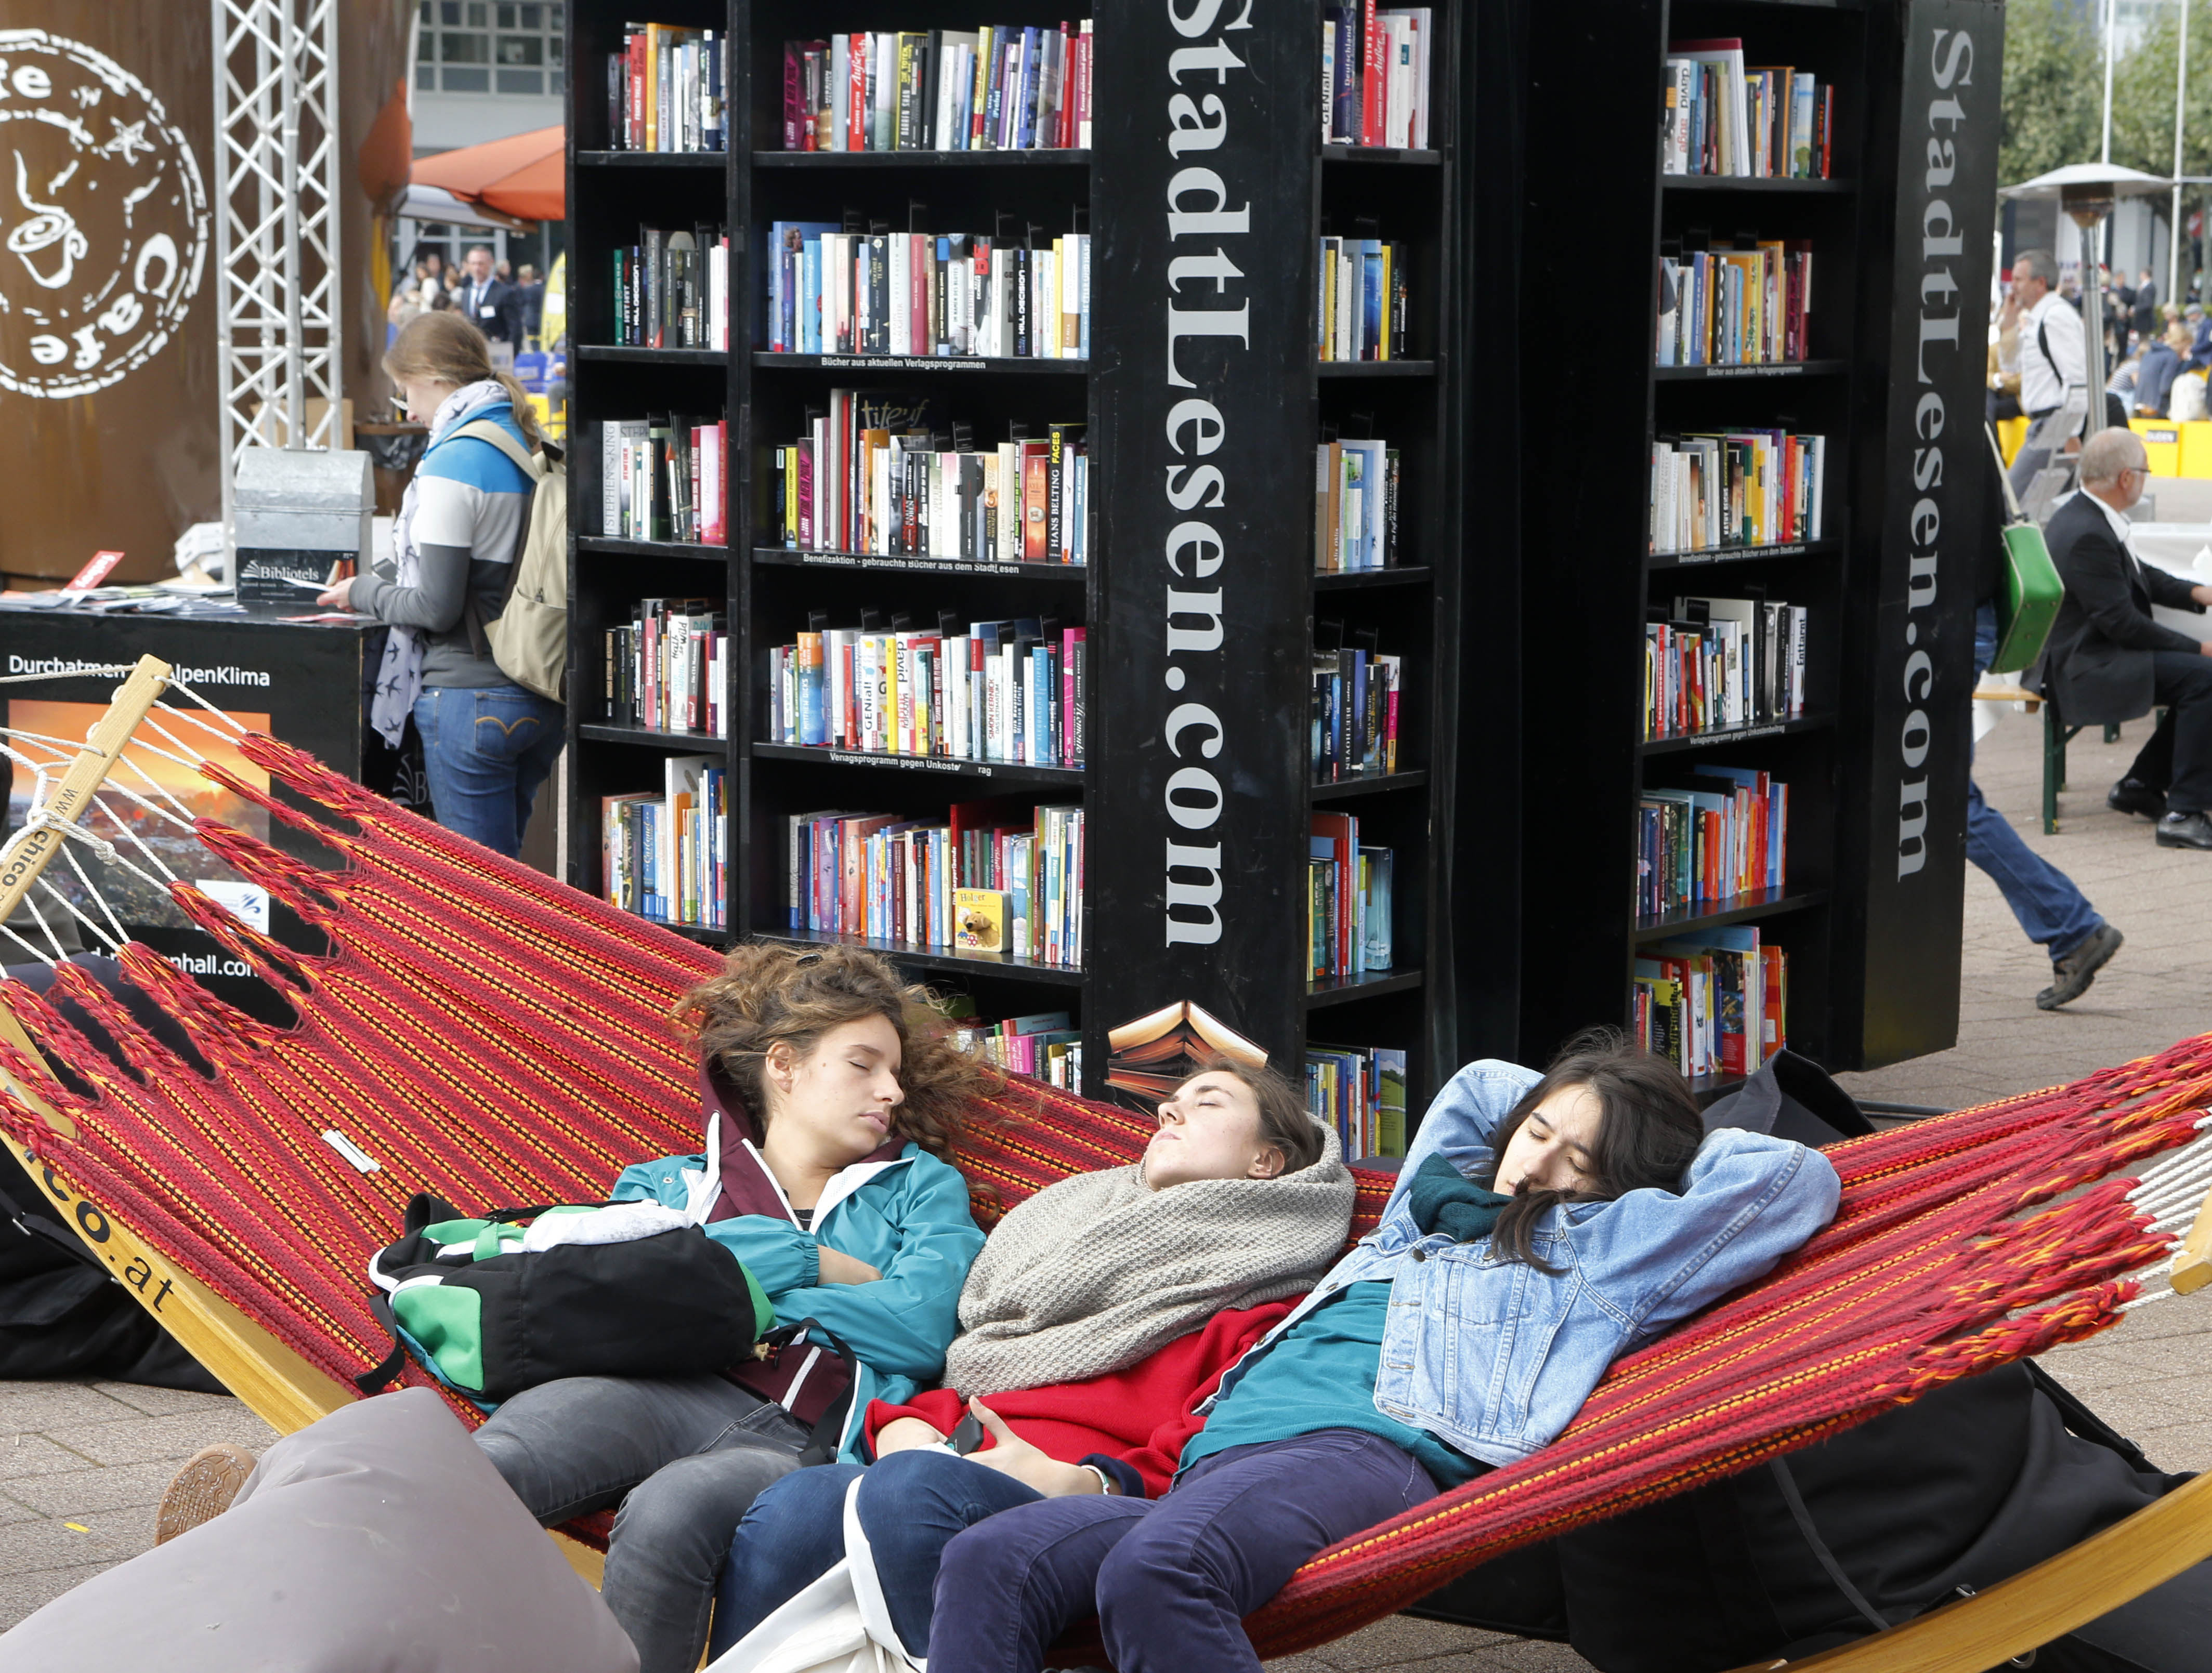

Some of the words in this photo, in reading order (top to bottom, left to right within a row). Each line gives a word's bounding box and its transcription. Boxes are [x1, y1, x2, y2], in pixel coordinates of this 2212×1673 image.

[851, 49, 864, 87] Außer
[1374, 38, 1385, 76] Außer
[901, 89, 910, 107] SHAN
[1680, 68, 1689, 108] david
[900, 110, 910, 136] DARREN
[30, 232, 178, 371] Cafe
[821, 357, 849, 367] Bücher
[867, 358, 904, 367] aktuellen
[905, 359, 986, 370] Verlagsprogrammen
[605, 426, 615, 455] KING
[1052, 431, 1060, 464] FACES
[1897, 28, 1973, 882] StadtLesen.com
[1050, 469, 1059, 515] BELTING
[1165, 0, 1253, 949] StadtLesen.com
[605, 471, 615, 526] STEPHEN
[1050, 517, 1059, 547] HANS
[260, 566, 319, 581] Bibliotels
[803, 554, 855, 565] Benefizaktion
[862, 558, 906, 568] gebrauchte
[908, 561, 936, 570] Bücher
[955, 562, 973, 571] dem
[974, 563, 1019, 574] StadtLesen
[678, 622, 687, 644] Wild
[1797, 618, 1806, 666] Enttarnt
[9, 654, 126, 679] Durchatmen
[897, 641, 908, 682] david
[646, 676, 652, 686] be
[863, 681, 872, 730] GENial!
[900, 759, 924, 769] gegen
[2, 830, 48, 887] chico
[960, 893, 985, 902] Holger
[23, 1149, 174, 1312] co.at
